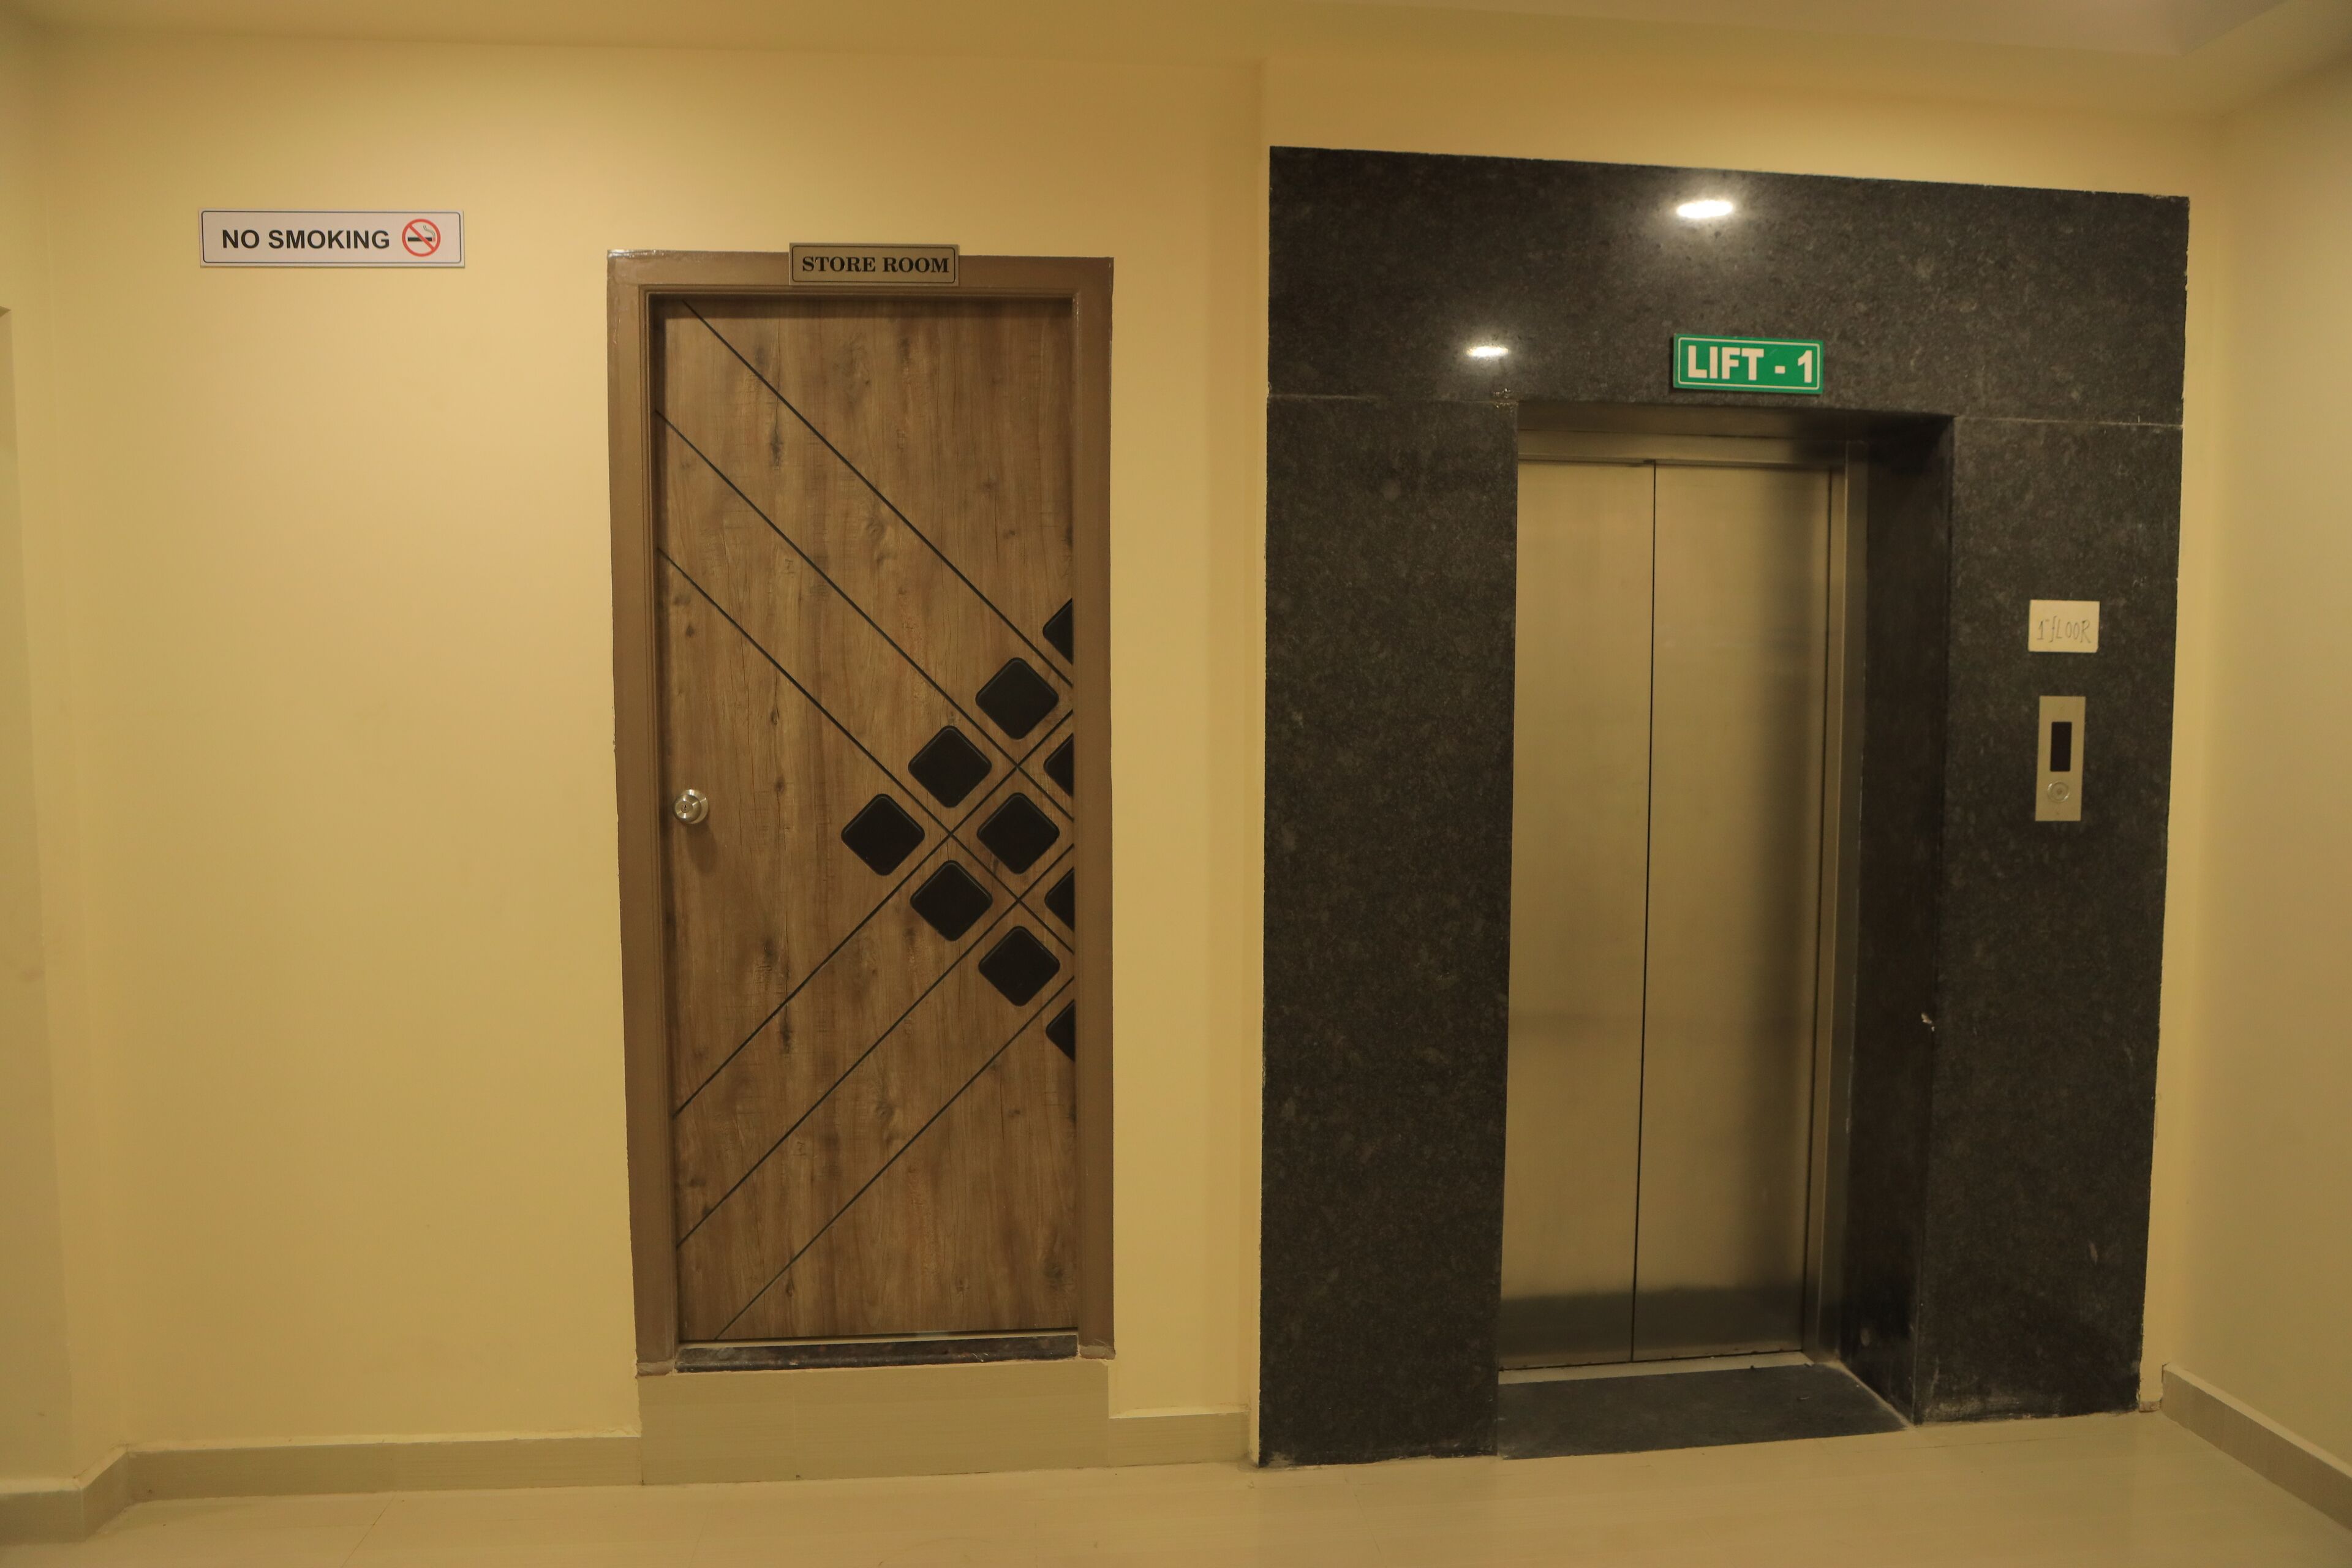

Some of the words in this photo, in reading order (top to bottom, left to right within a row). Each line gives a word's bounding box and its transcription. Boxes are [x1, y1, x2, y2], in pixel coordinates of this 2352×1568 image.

[222, 229, 260, 249] NO
[268, 229, 390, 249] SMOKING
[802, 256, 876, 273] STORE
[882, 257, 949, 273] ROOM
[1687, 345, 1765, 381] LIFT
[1774, 365, 1785, 374] -
[1798, 350, 1813, 383] 1
